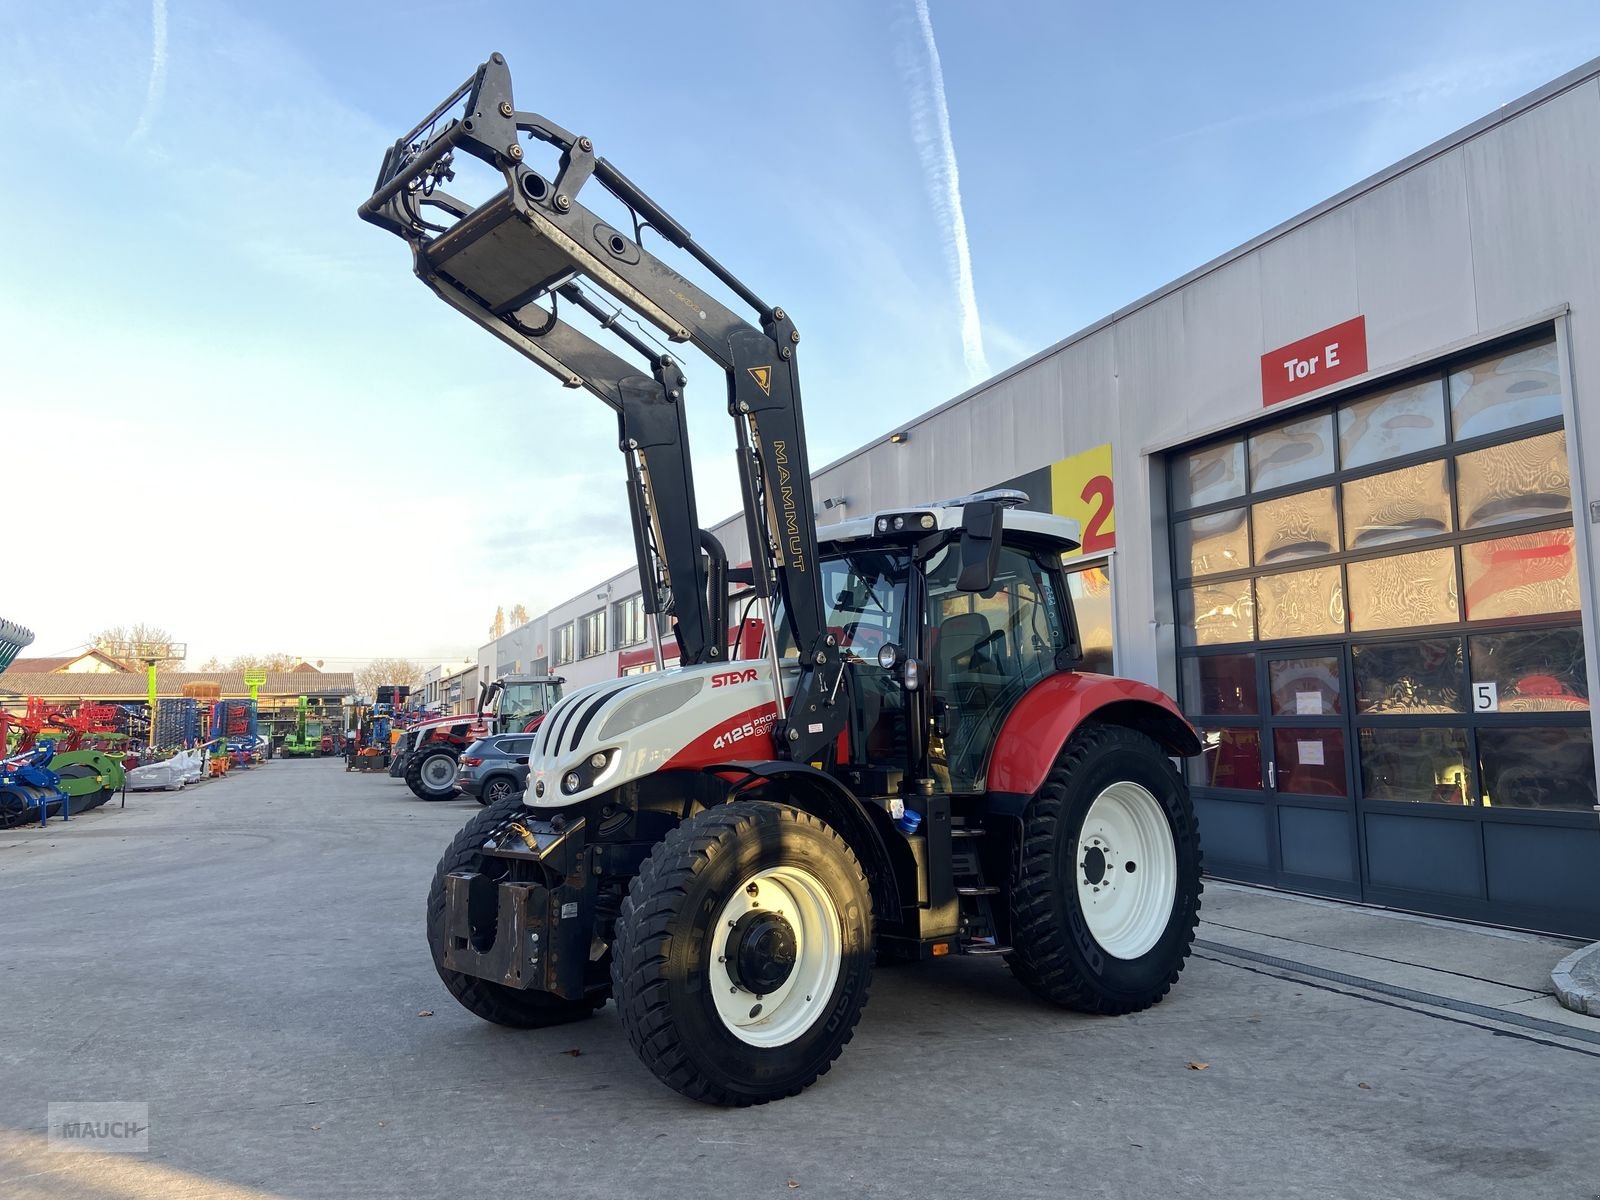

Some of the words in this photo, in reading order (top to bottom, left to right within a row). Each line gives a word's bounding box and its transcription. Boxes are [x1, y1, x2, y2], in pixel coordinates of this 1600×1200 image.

[1284, 356, 1319, 383] Tor
[1325, 342, 1340, 369] E
[773, 440, 805, 572] MAMMUT
[1080, 475, 1116, 555] 2
[711, 669, 758, 688] STEYR
[1479, 686, 1492, 709] 5
[713, 722, 754, 749] 4125
[753, 713, 777, 726] PROF
[754, 723, 774, 737] CVT
